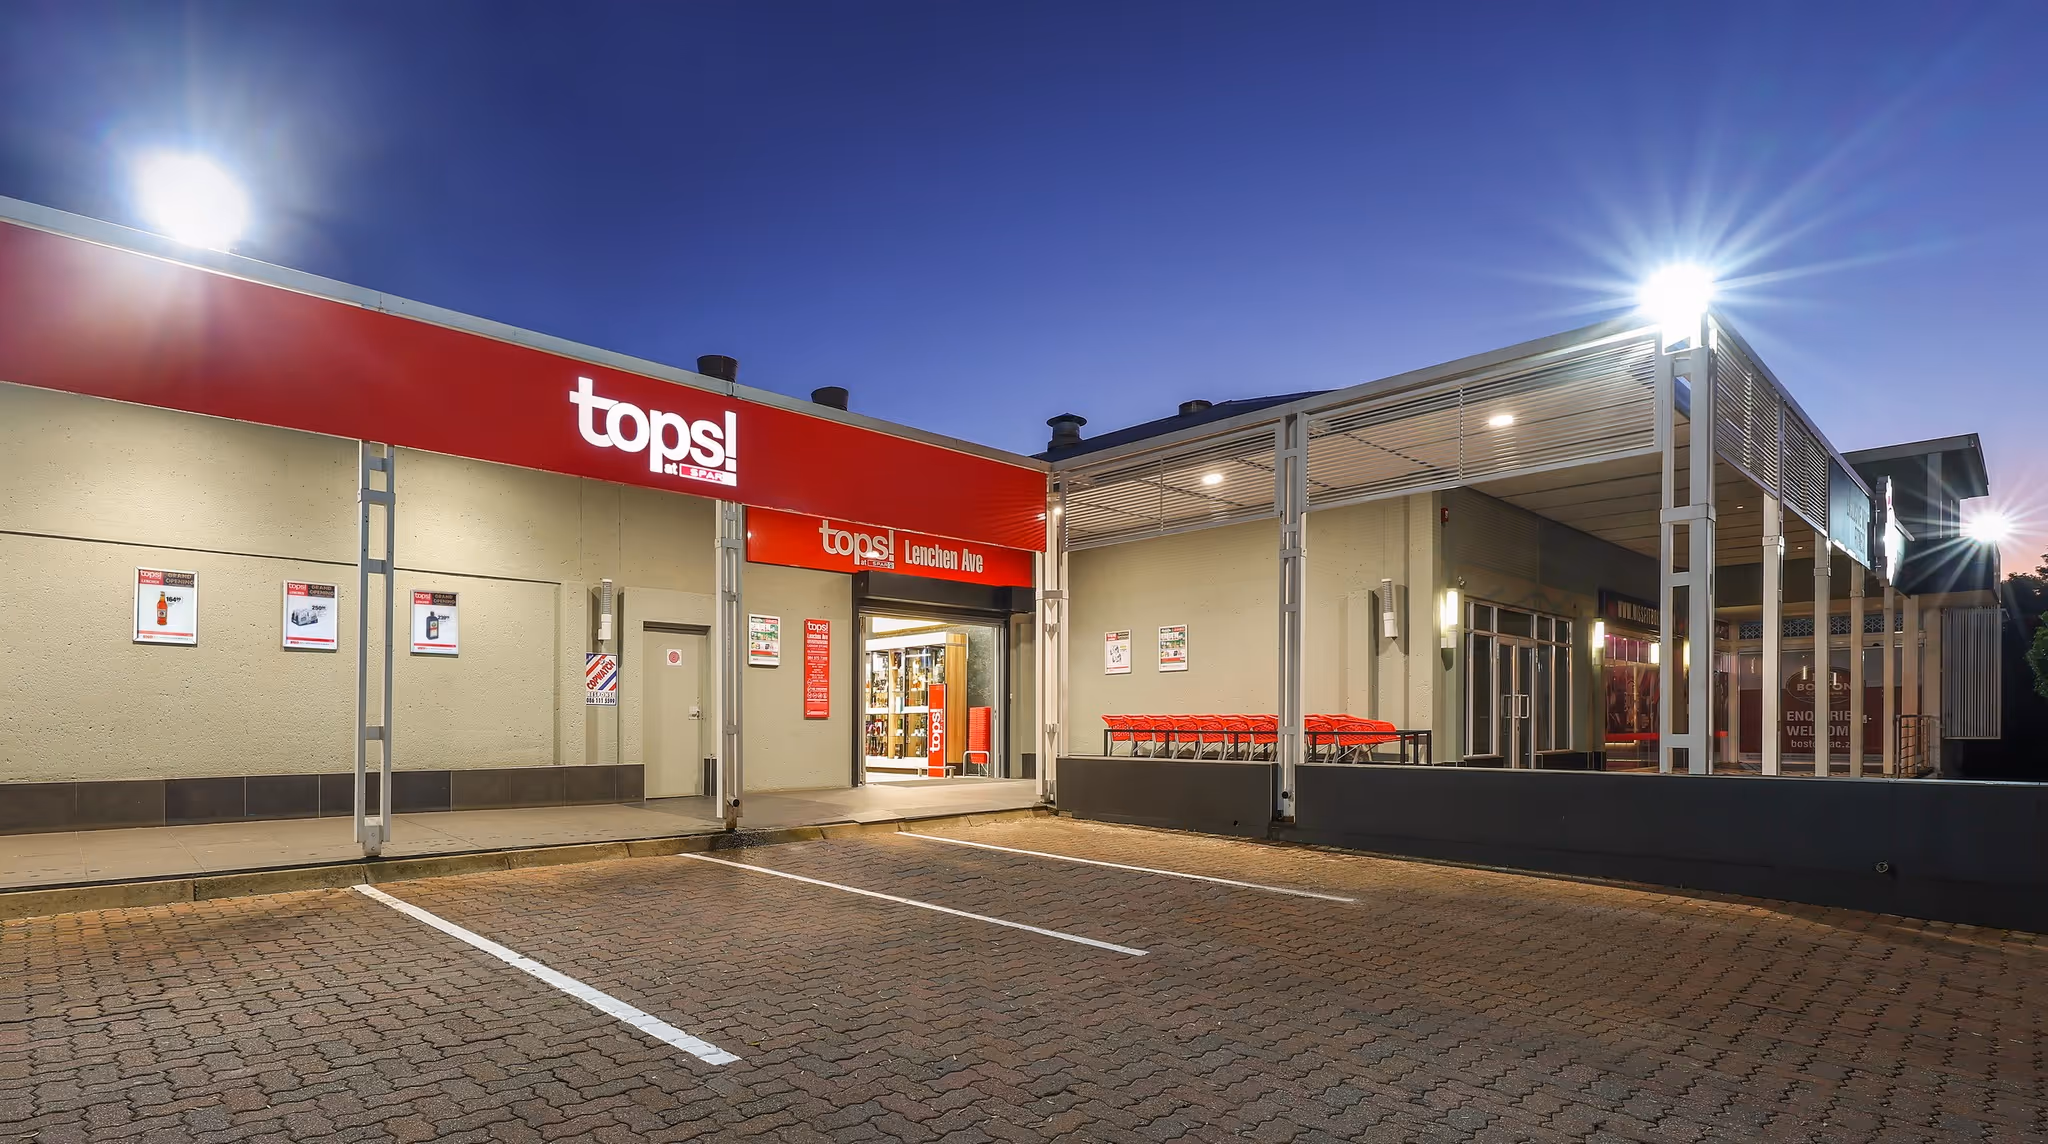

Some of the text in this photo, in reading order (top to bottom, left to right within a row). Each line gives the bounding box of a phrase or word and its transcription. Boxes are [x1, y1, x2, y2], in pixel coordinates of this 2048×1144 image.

[569, 376, 737, 474] tops!
[664, 463, 724, 482] at SPAR
[819, 520, 895, 566] tops!
[904, 540, 984, 574] Lenchen Ave
[586, 659, 615, 690] COPWATCH
[1796, 682, 1851, 692] BOON
[930, 708, 944, 753] tops!
[1786, 710, 1852, 722] ENQRIE
[1786, 725, 1850, 737] WELOM
